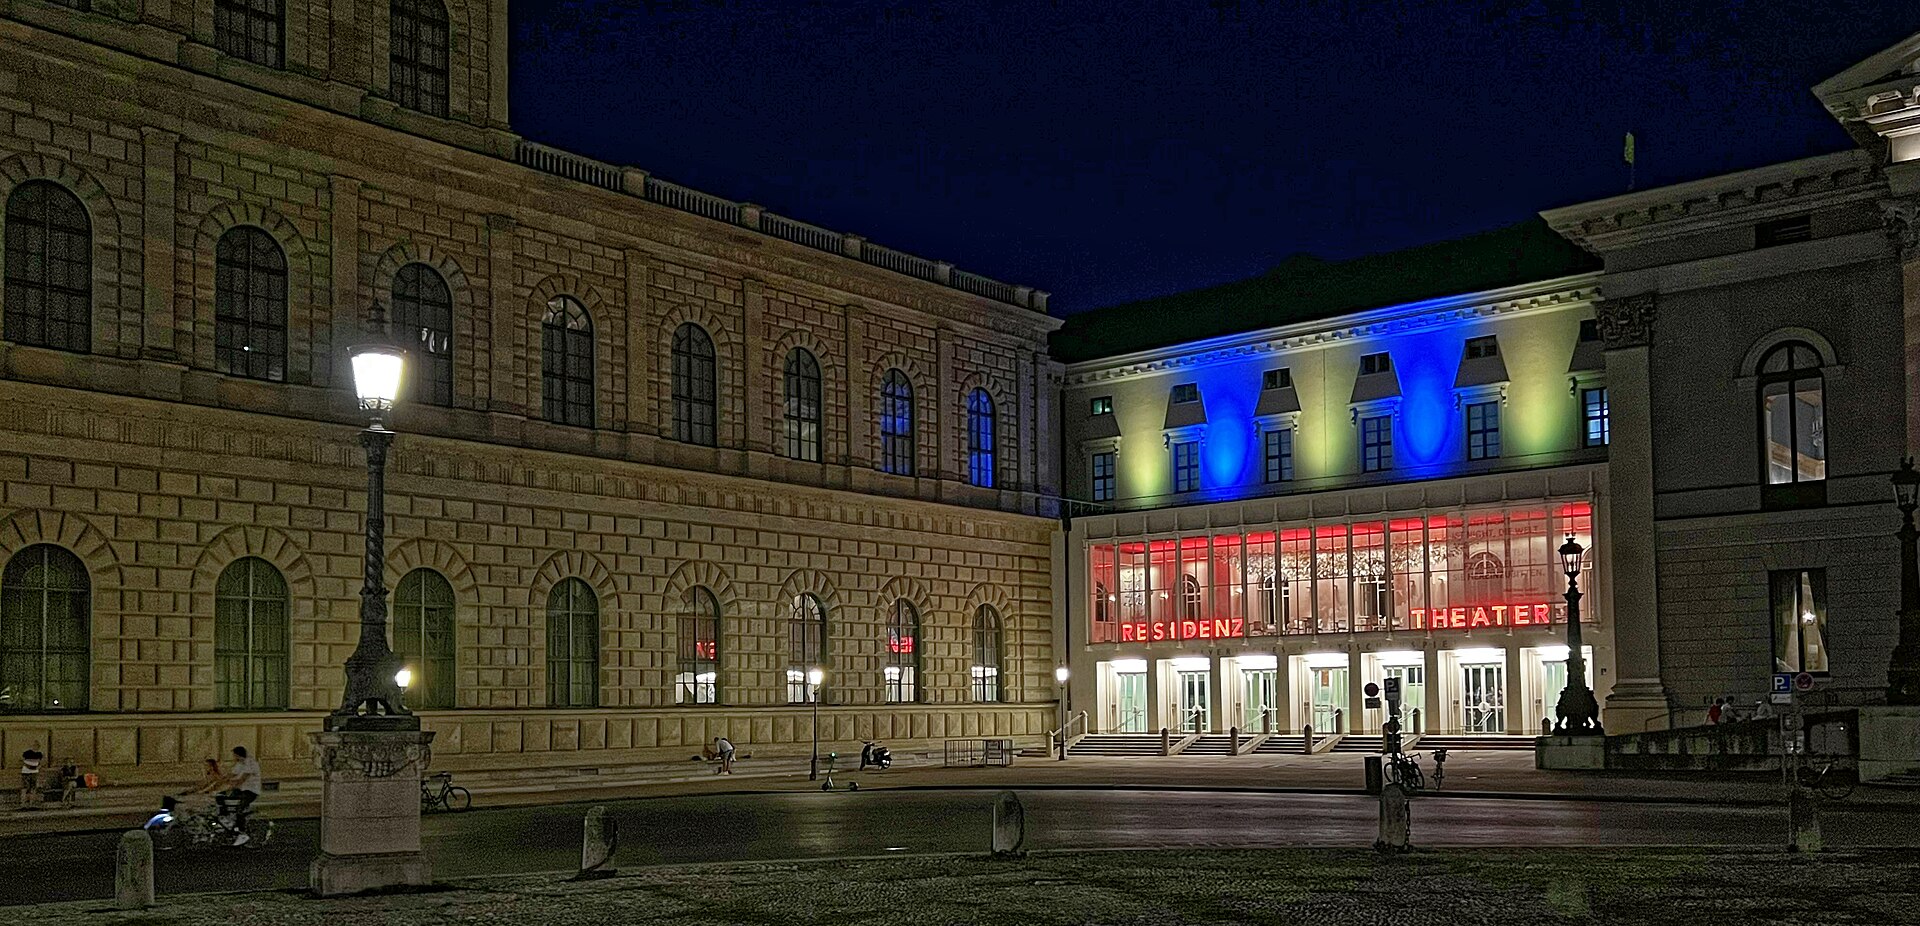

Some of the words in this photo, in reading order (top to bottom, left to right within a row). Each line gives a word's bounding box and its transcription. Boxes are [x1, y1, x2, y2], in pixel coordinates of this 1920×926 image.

[1411, 603, 1551, 629] THEATER
[1122, 618, 1244, 642] RESIDENZ
[1774, 677, 1785, 690] P
